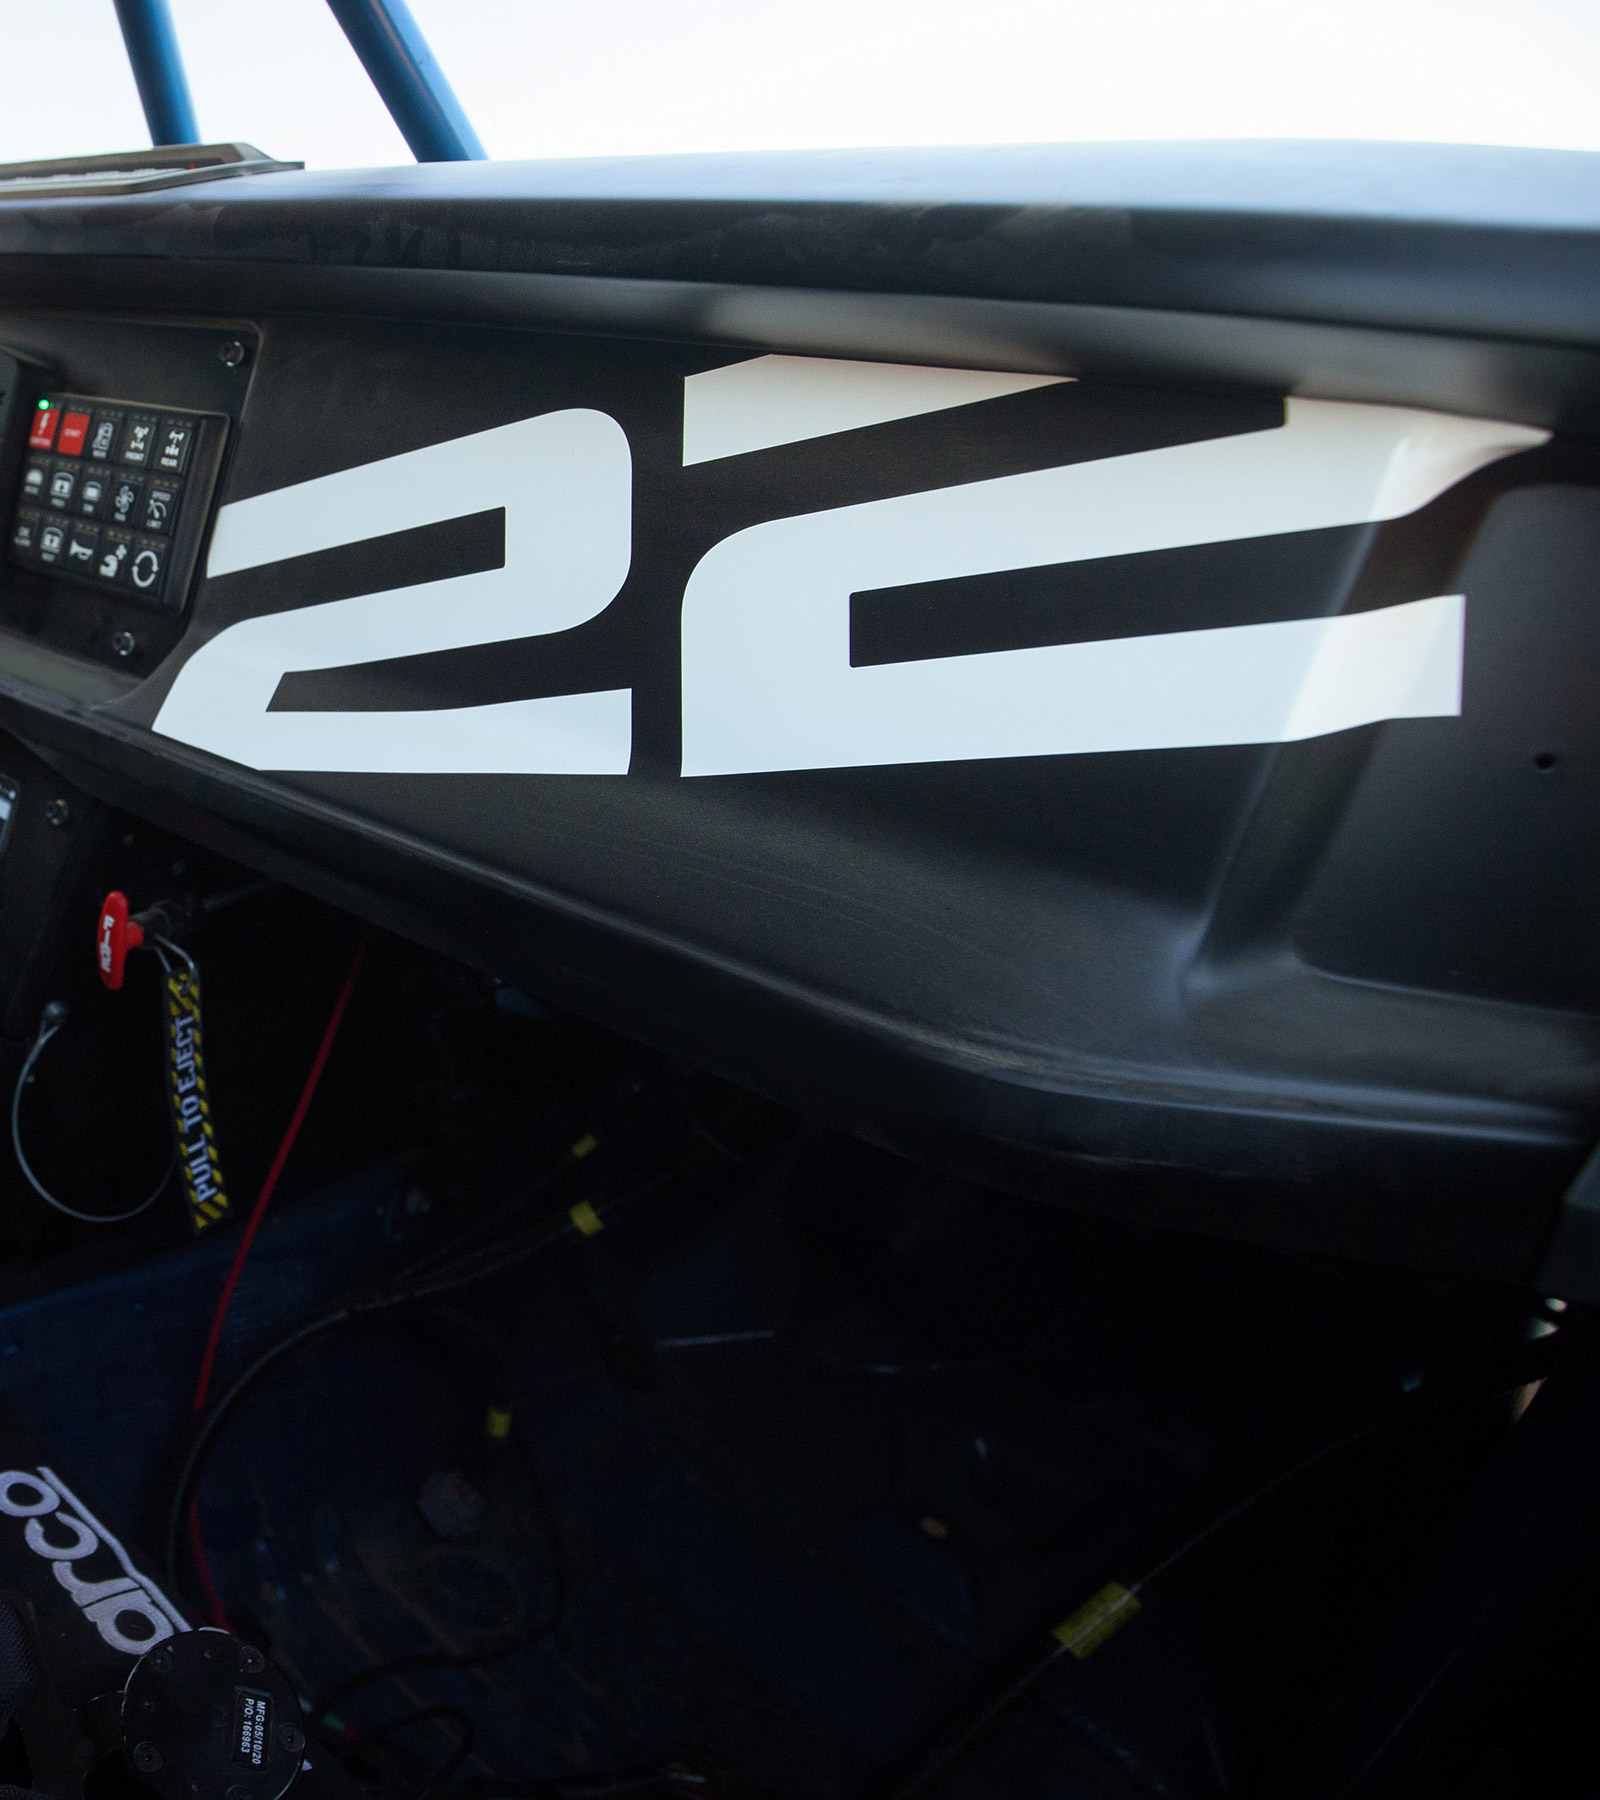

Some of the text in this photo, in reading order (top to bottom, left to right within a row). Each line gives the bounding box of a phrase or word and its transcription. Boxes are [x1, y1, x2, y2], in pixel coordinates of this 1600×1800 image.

[153, 354, 1554, 778] 22
[174, 1015, 218, 1203] PULL TO EJECT
[240, 1697, 256, 1754] P/O: 166963
[252, 1700, 267, 1765] MFG:05/10/20
